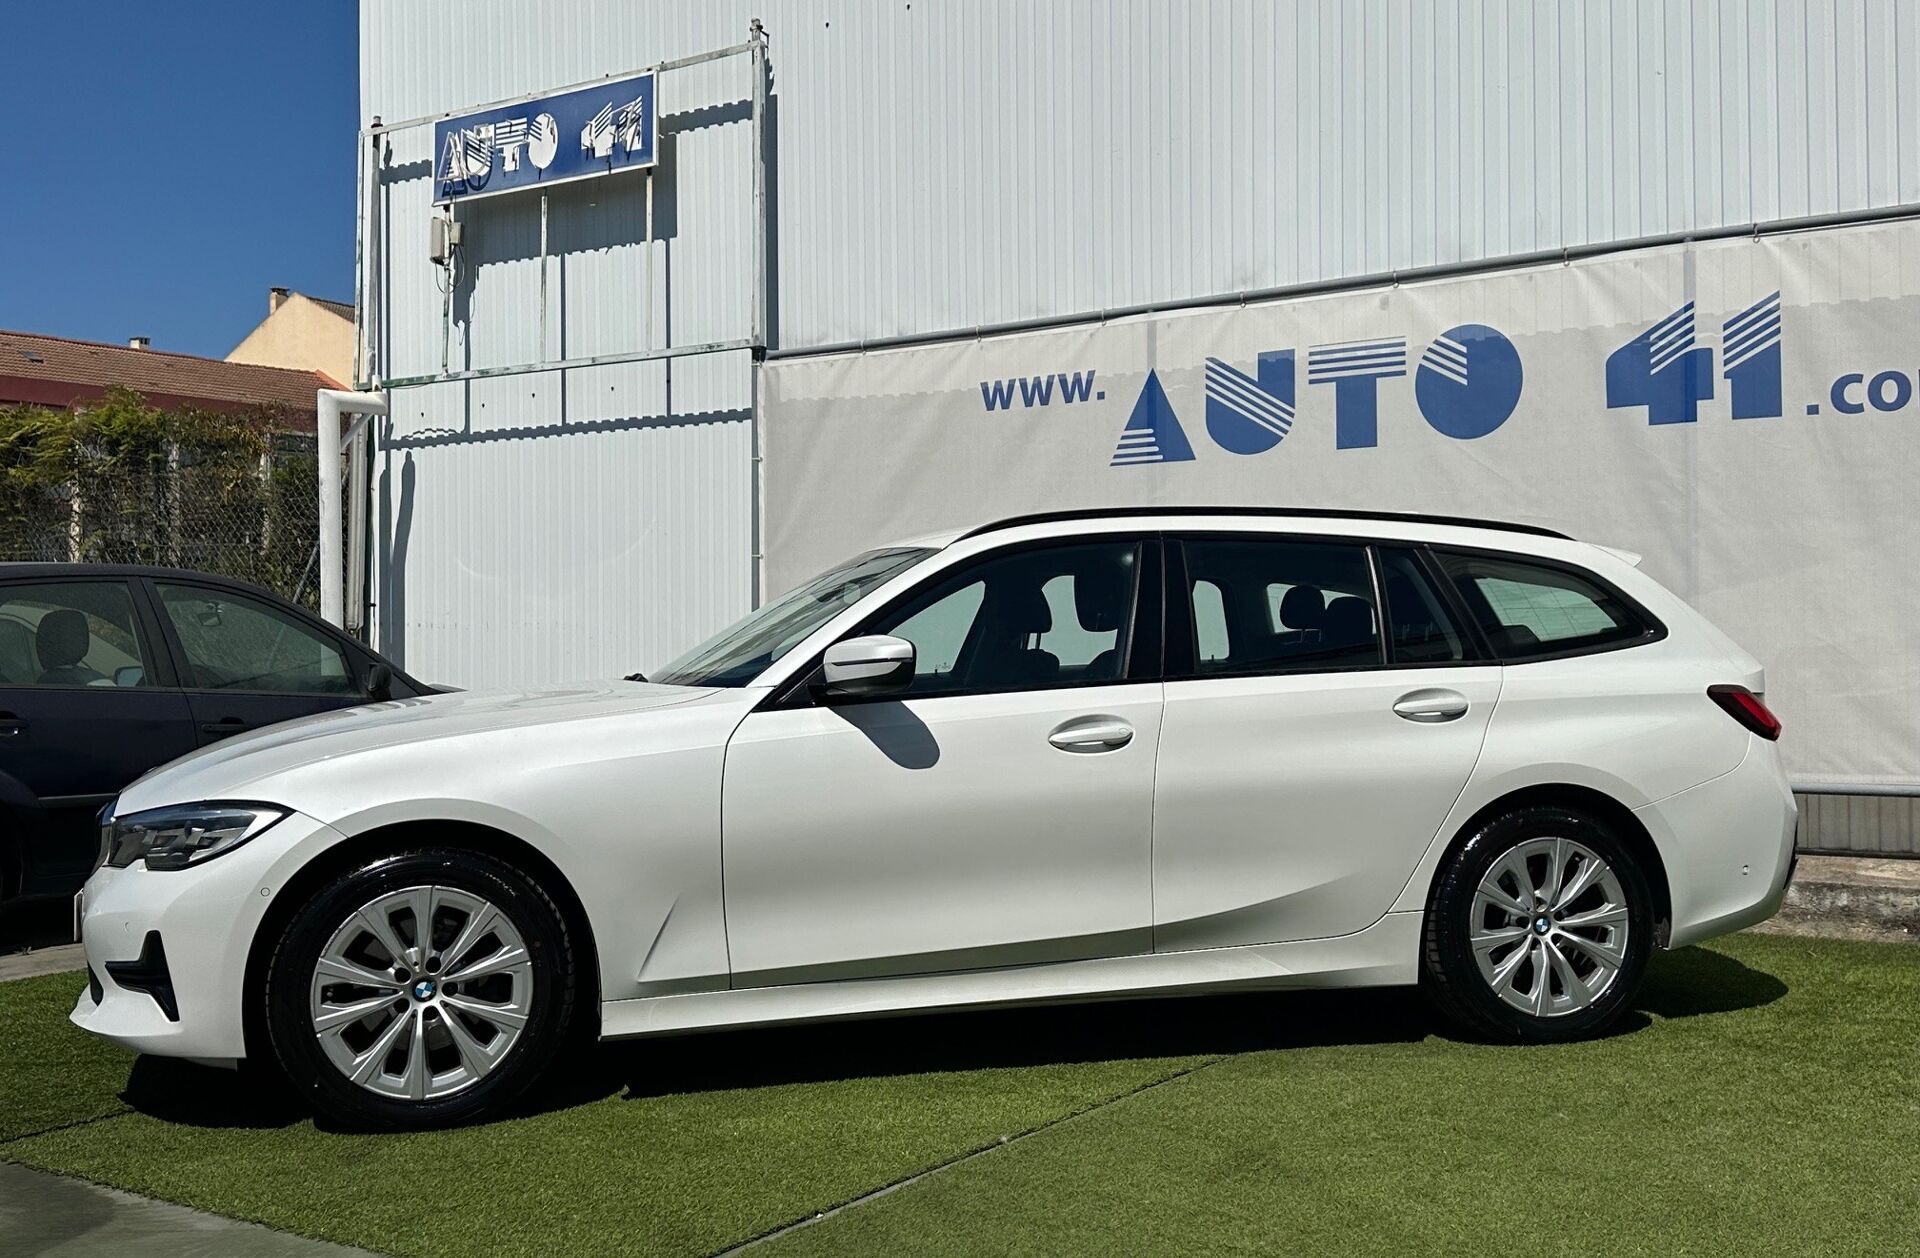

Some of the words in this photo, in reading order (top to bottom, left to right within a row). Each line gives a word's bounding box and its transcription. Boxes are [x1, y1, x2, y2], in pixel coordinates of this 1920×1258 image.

[437, 112, 559, 181] AUTO
[581, 95, 643, 158] 41
[1110, 323, 1524, 466] AUTO
[1606, 290, 1783, 426] 41
[1806, 369, 1920, 416] .co
